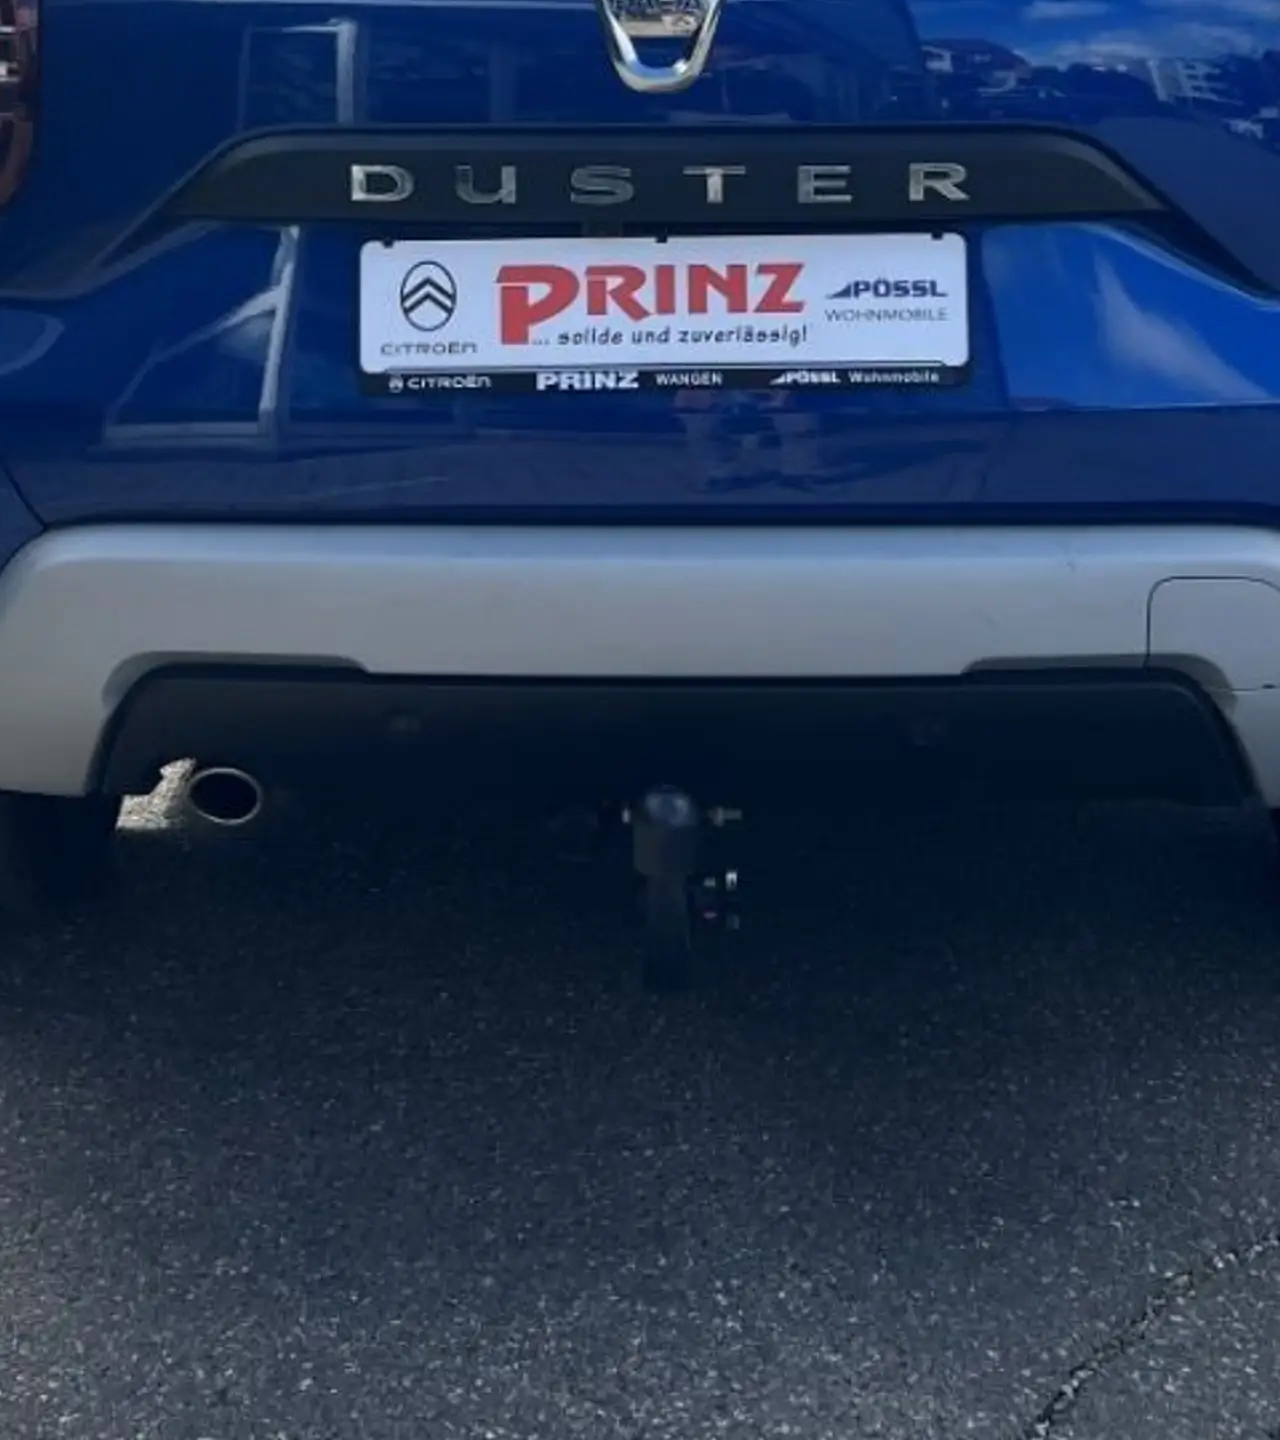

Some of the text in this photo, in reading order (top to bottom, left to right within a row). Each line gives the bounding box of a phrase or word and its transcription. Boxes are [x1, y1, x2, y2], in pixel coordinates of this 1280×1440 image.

[350, 162, 971, 204] DUSTER
[853, 277, 949, 298] PÖSSL
[494, 263, 807, 346] PRINZ
[824, 308, 948, 323] WOHNMOBILE
[557, 327, 624, 346] solide
[631, 325, 671, 345] und
[678, 324, 808, 348] zuverlässig!
[380, 340, 478, 356] CITROËN
[406, 369, 940, 391] CITROËN PRINZ WANGEN PÖSSL Wohnmobile
